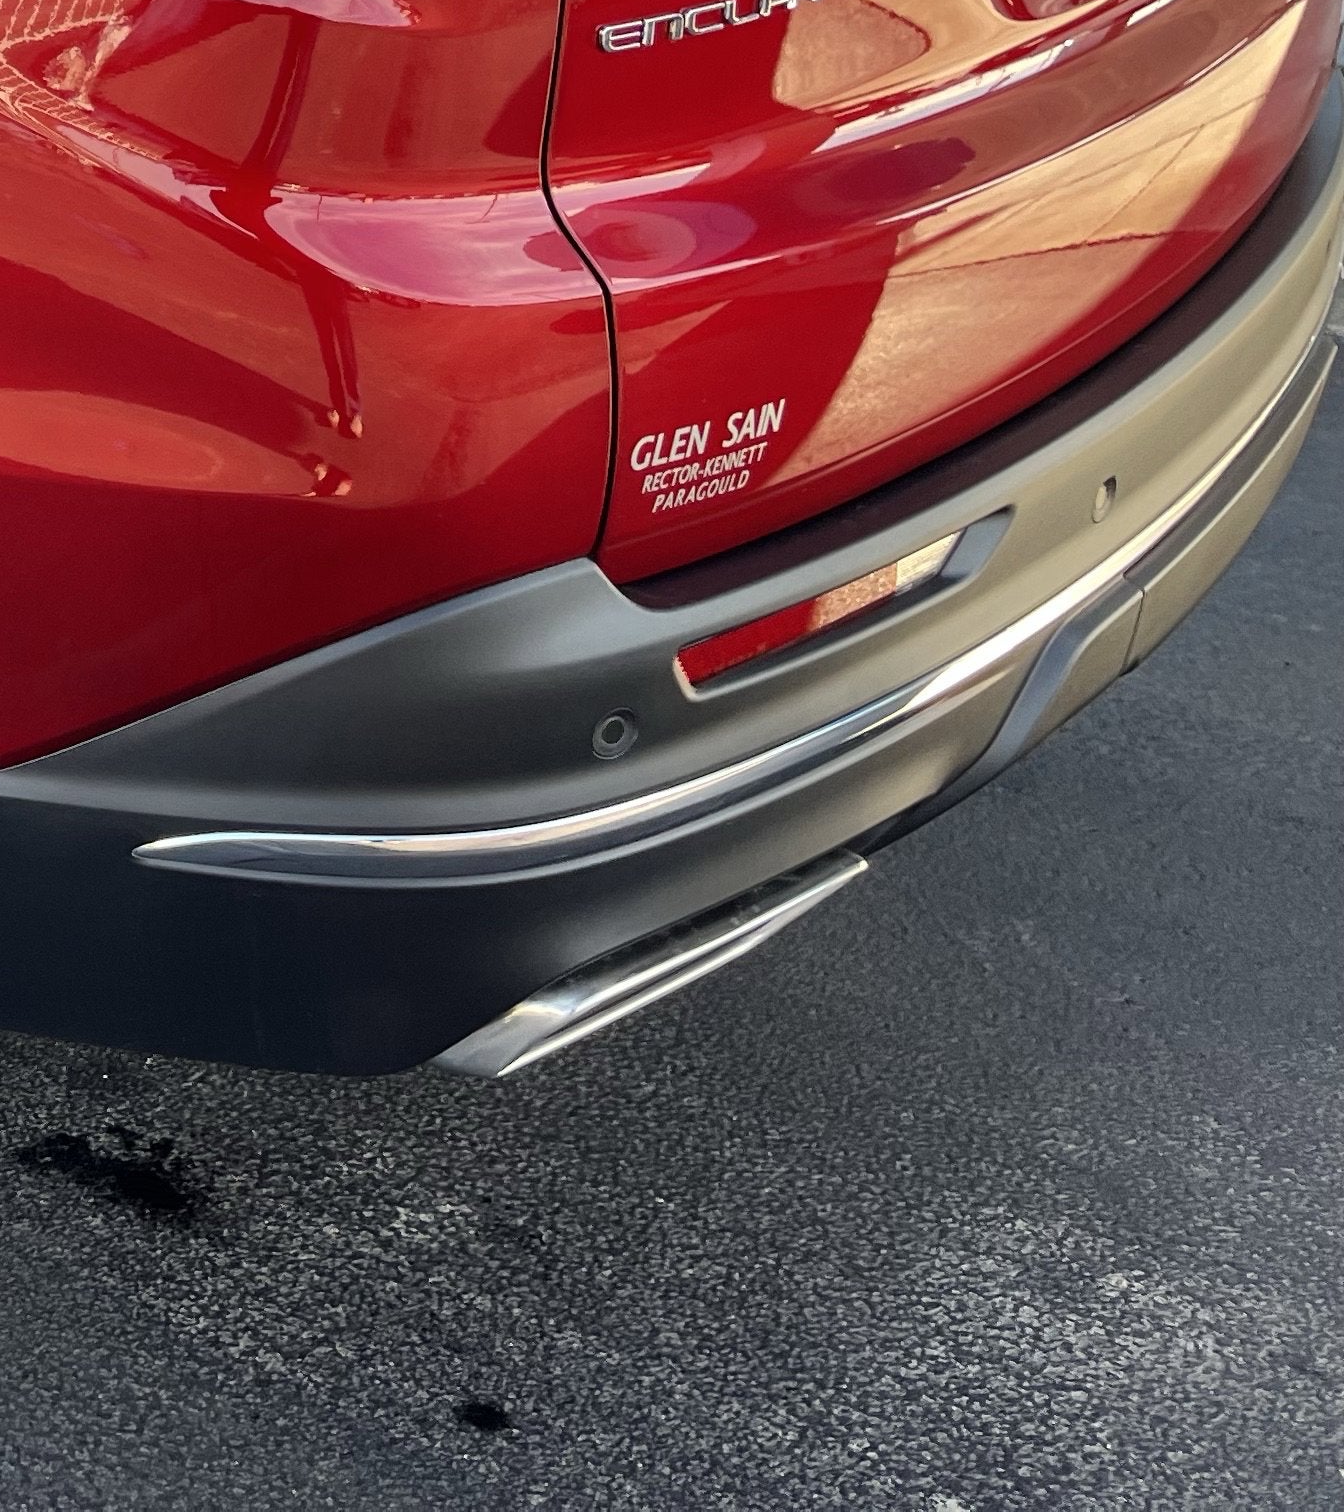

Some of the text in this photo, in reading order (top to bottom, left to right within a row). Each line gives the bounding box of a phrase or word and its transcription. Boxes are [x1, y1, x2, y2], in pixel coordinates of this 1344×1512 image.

[630, 398, 786, 471] GLEN SAIN
[641, 441, 768, 494] RECTOR-KENNETT
[651, 469, 751, 513] PARAGOULD
